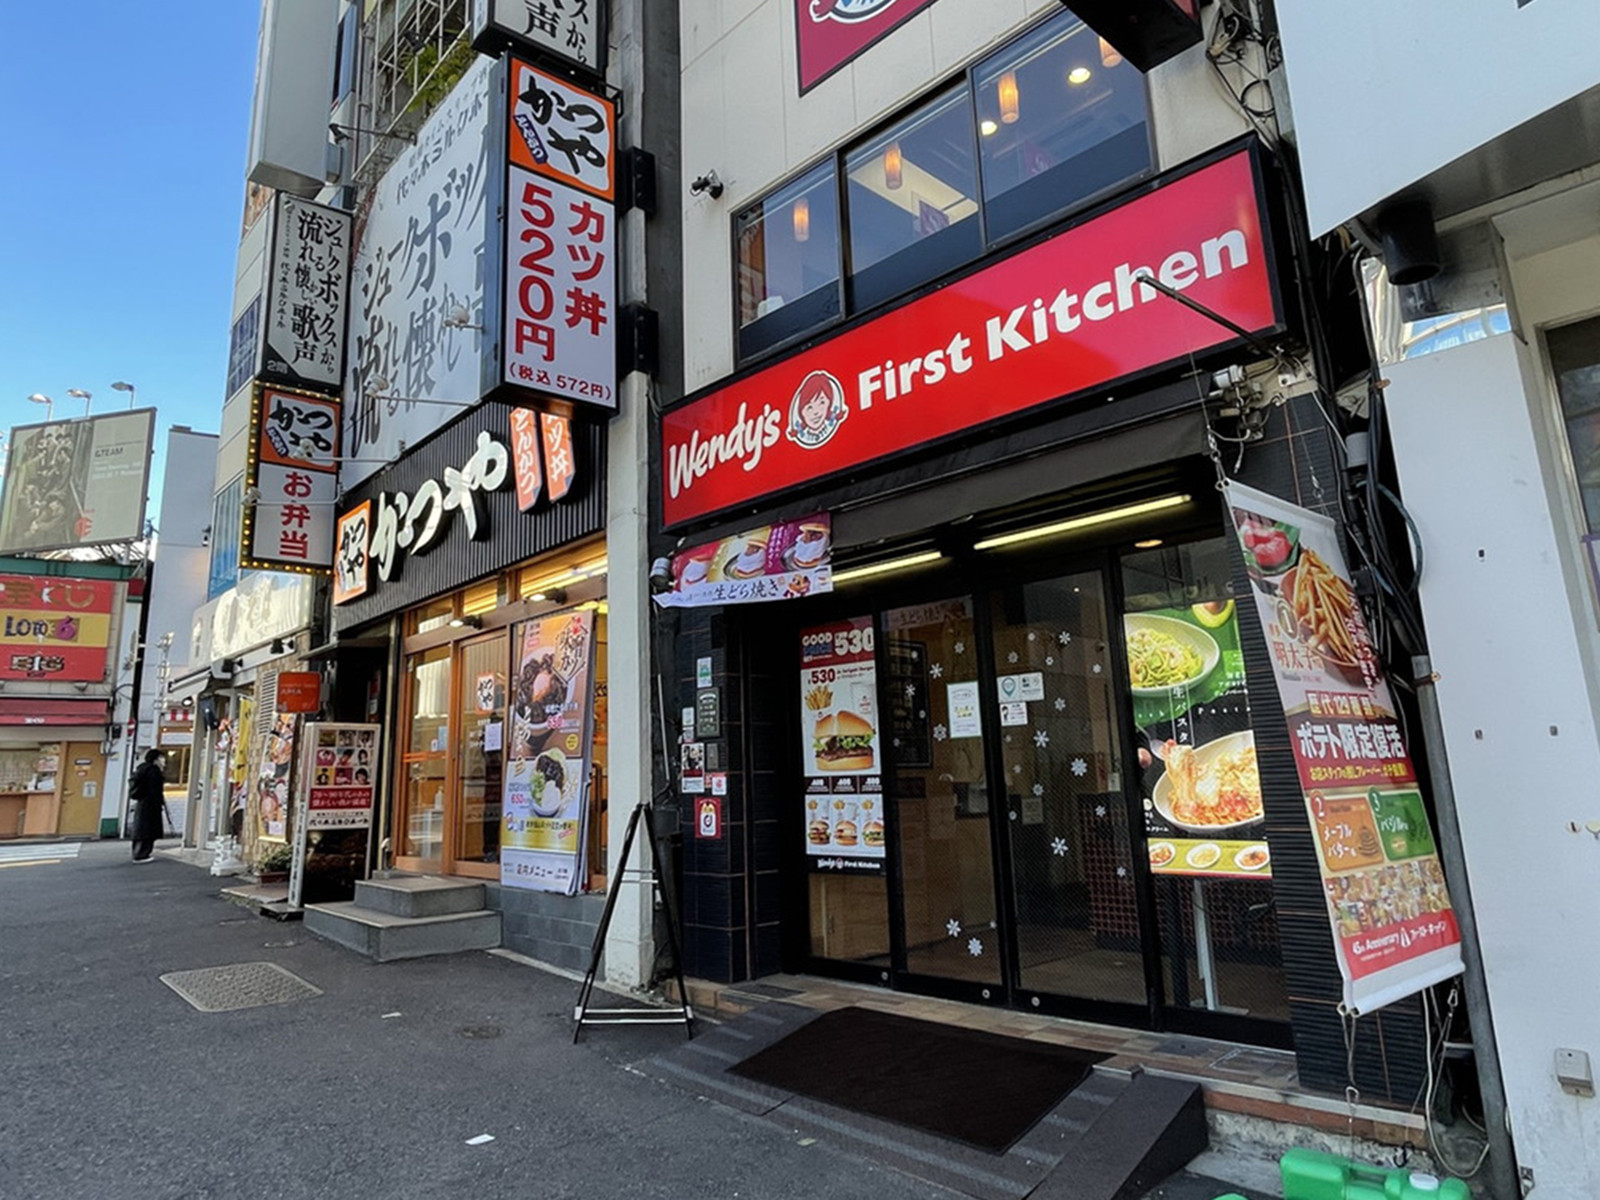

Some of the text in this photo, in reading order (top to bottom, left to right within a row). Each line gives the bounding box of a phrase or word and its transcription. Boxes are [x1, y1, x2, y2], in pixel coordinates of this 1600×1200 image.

[524, 0, 565, 38] 声
[518, 75, 606, 175] かつや
[515, 182, 555, 362] 520円
[565, 200, 607, 336] カツ丼
[857, 228, 1249, 411] First Kitchen
[270, 400, 333, 459] かつや
[668, 401, 782, 499] Wendy's
[279, 472, 313, 559] お弁当
[369, 430, 509, 583] かつや
[712, 579, 779, 602] 生どら焼き
[802, 632, 833, 646] GOOD
[834, 626, 875, 656] 530
[811, 668, 836, 685] 530
[1296, 721, 1407, 760] ポテト限定復活
